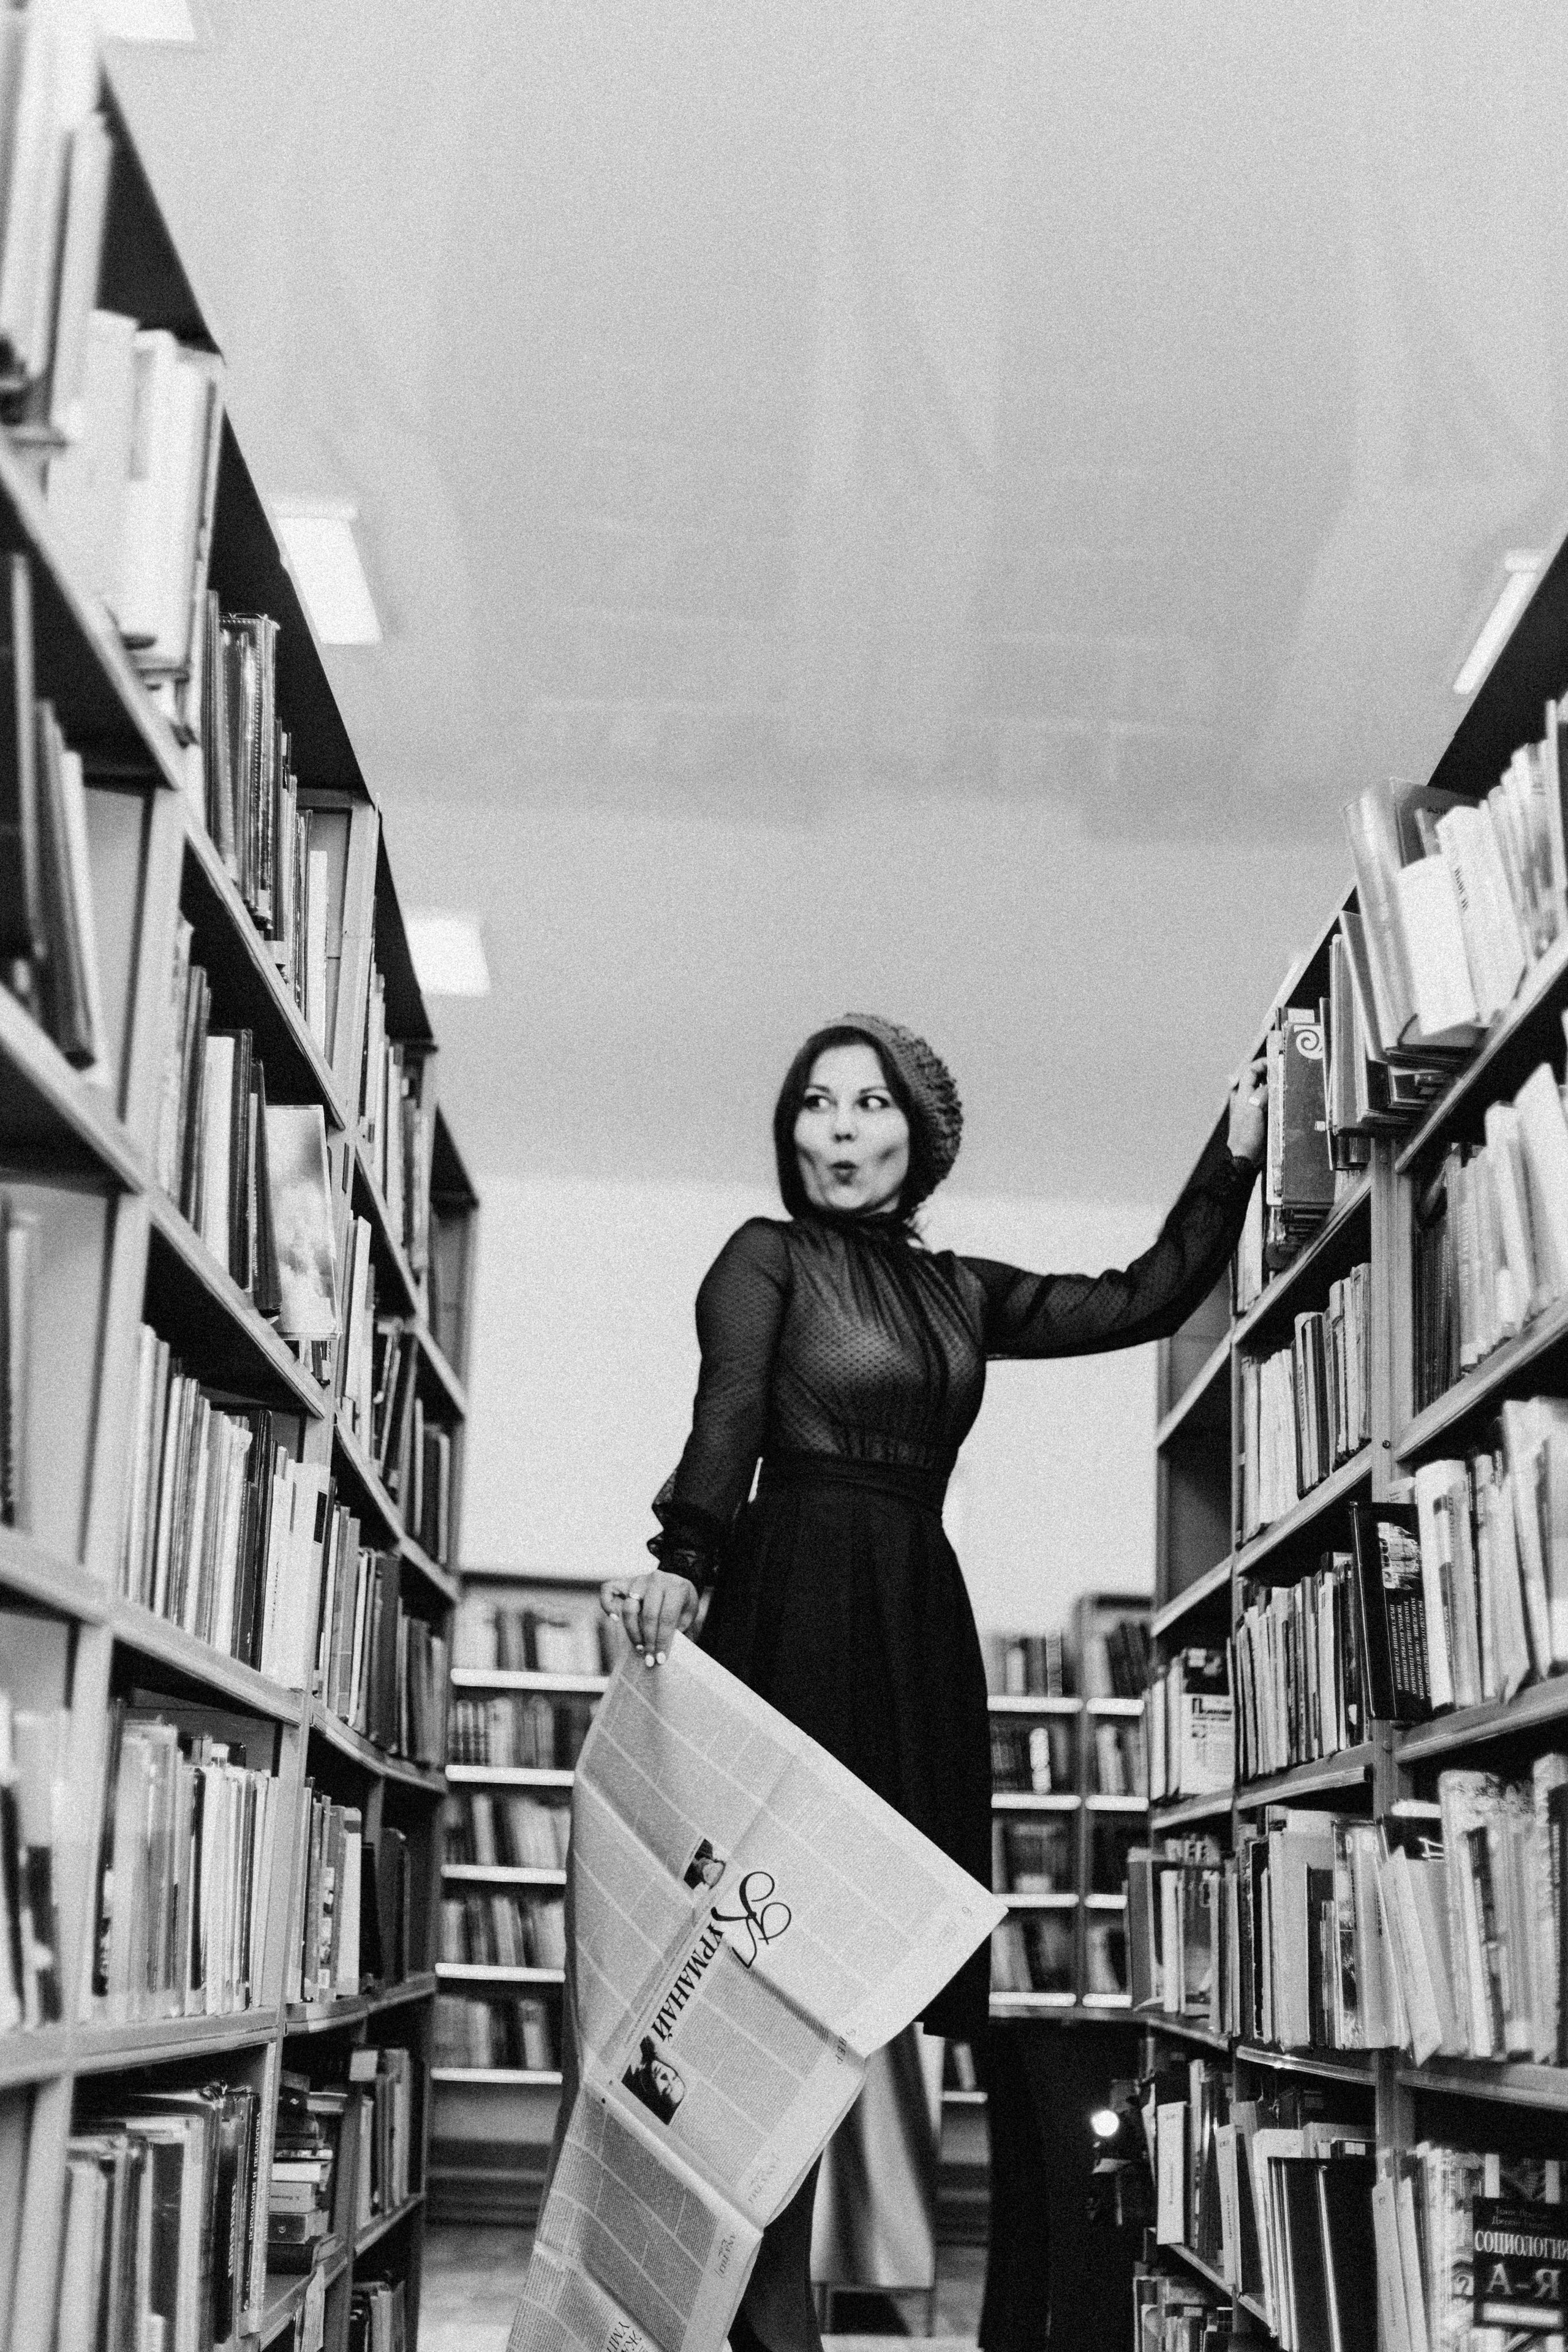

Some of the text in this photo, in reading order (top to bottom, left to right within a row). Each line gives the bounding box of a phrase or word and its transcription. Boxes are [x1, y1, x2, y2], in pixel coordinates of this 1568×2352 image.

[1390, 1604, 1398, 1649] ПРЕДСТАВЛЕНИЕ
[253, 2112, 262, 2168] ПЕДАГОГИКА
[1474, 2230, 1568, 2260] СОЦИОЛОГИЯ
